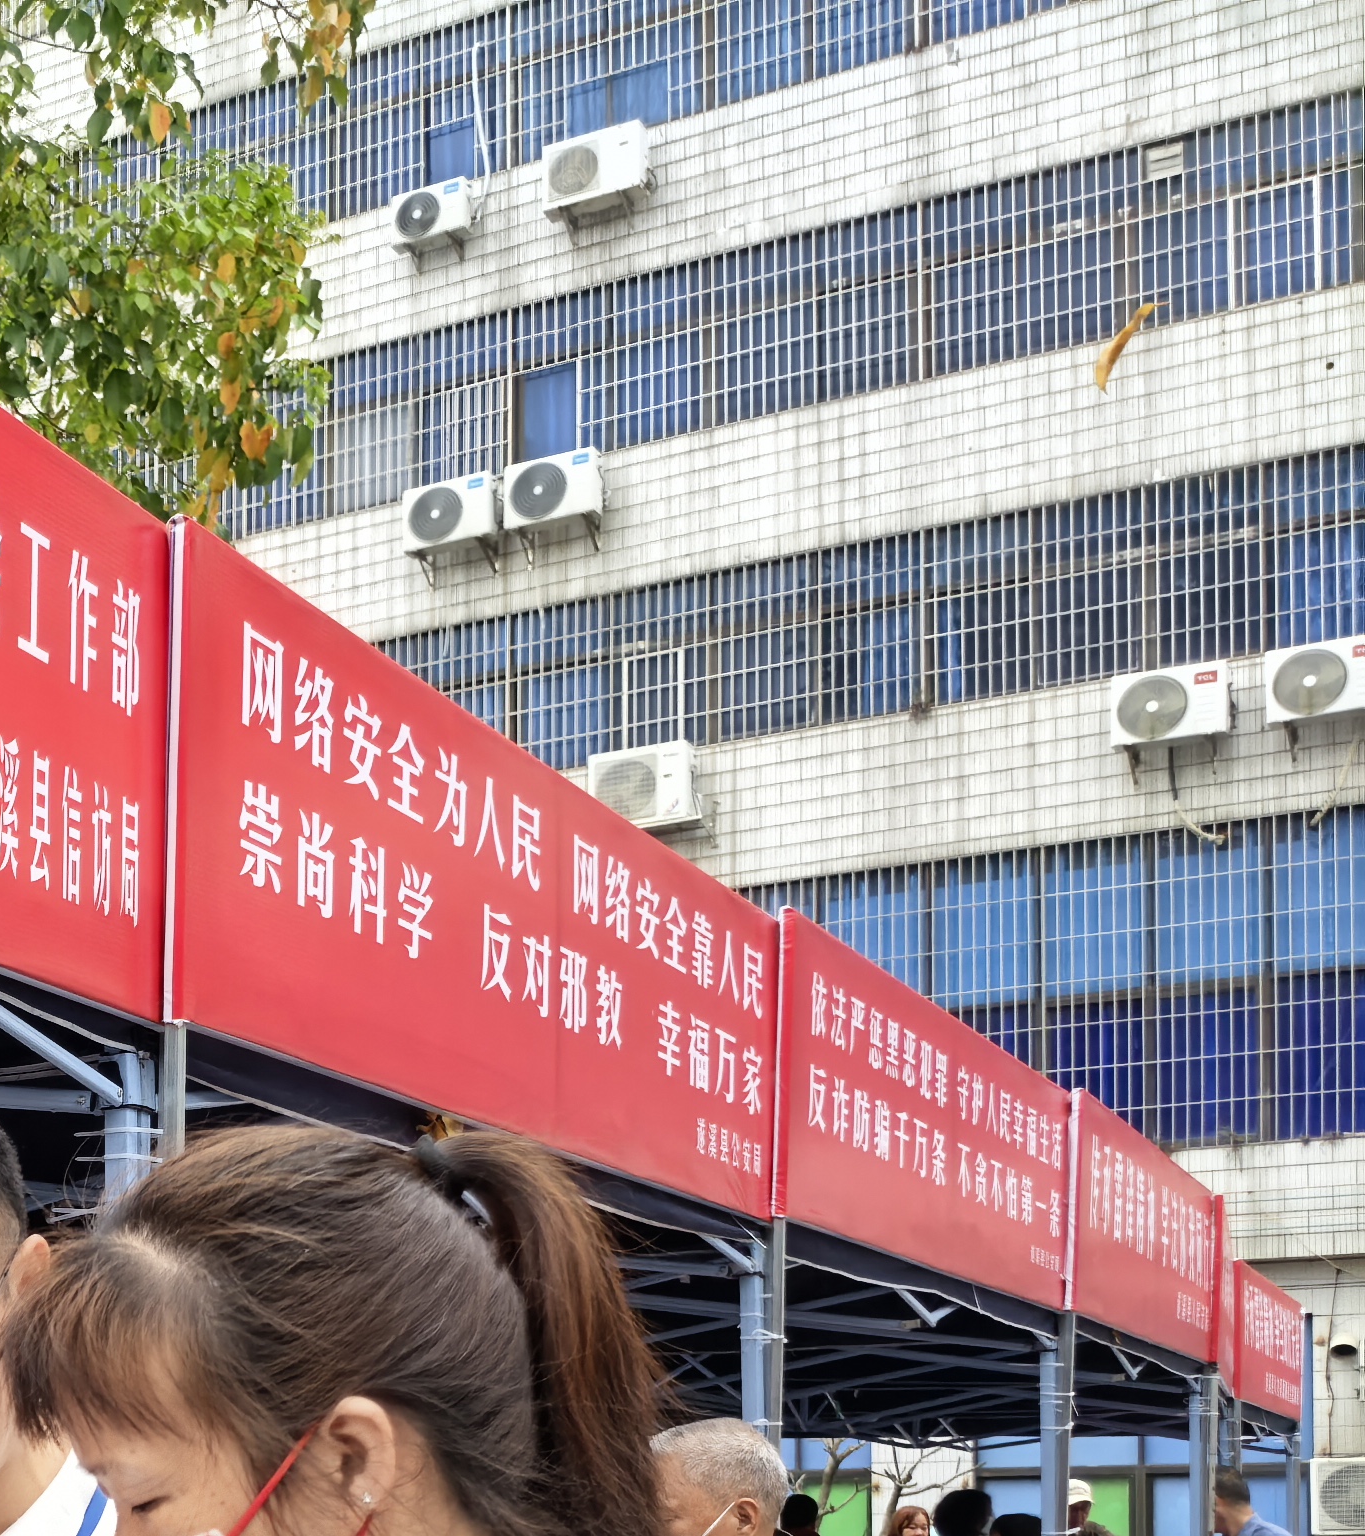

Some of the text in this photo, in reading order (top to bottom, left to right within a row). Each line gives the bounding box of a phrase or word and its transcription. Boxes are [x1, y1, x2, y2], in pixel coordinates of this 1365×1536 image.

[241, 621, 764, 1020] 网络安全为人民 网络安全靠人民
[239, 781, 764, 1116] 崇尚科学 反对邪教 幸福万家
[696, 1117, 762, 1178] 遂溪县公安局
[807, 1063, 1061, 1238] 反诈防骗千万条 不贪不怕第一条
[810, 971, 1063, 1171] 依法严惩黑恶犯罪 守护人民幸福生活
[1089, 1133, 1156, 1262] 传承雷锋精神
